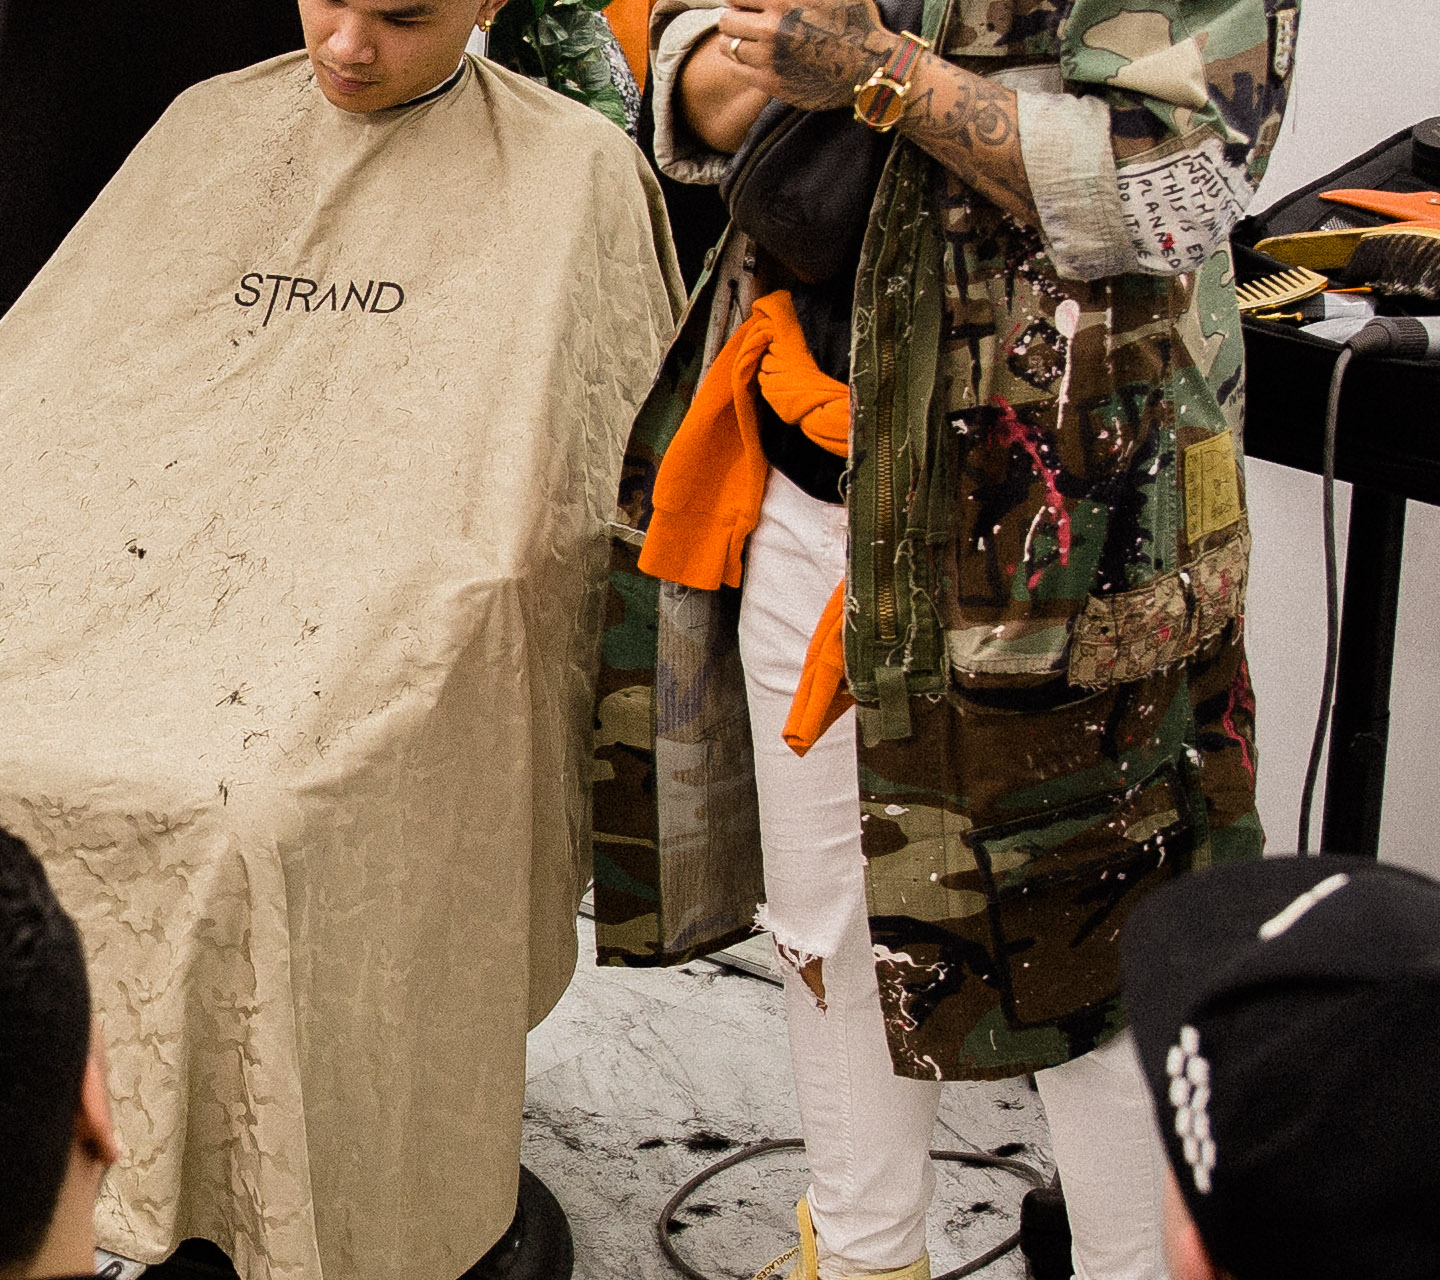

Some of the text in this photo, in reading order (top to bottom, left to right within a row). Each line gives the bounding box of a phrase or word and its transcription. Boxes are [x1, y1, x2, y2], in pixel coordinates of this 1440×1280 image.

[1118, 180, 1131, 202] DO
[1161, 170, 1188, 213] THIS
[1178, 219, 1198, 233] IS
[1136, 178, 1182, 270] PLANNED
[234, 271, 405, 328] STRAND
